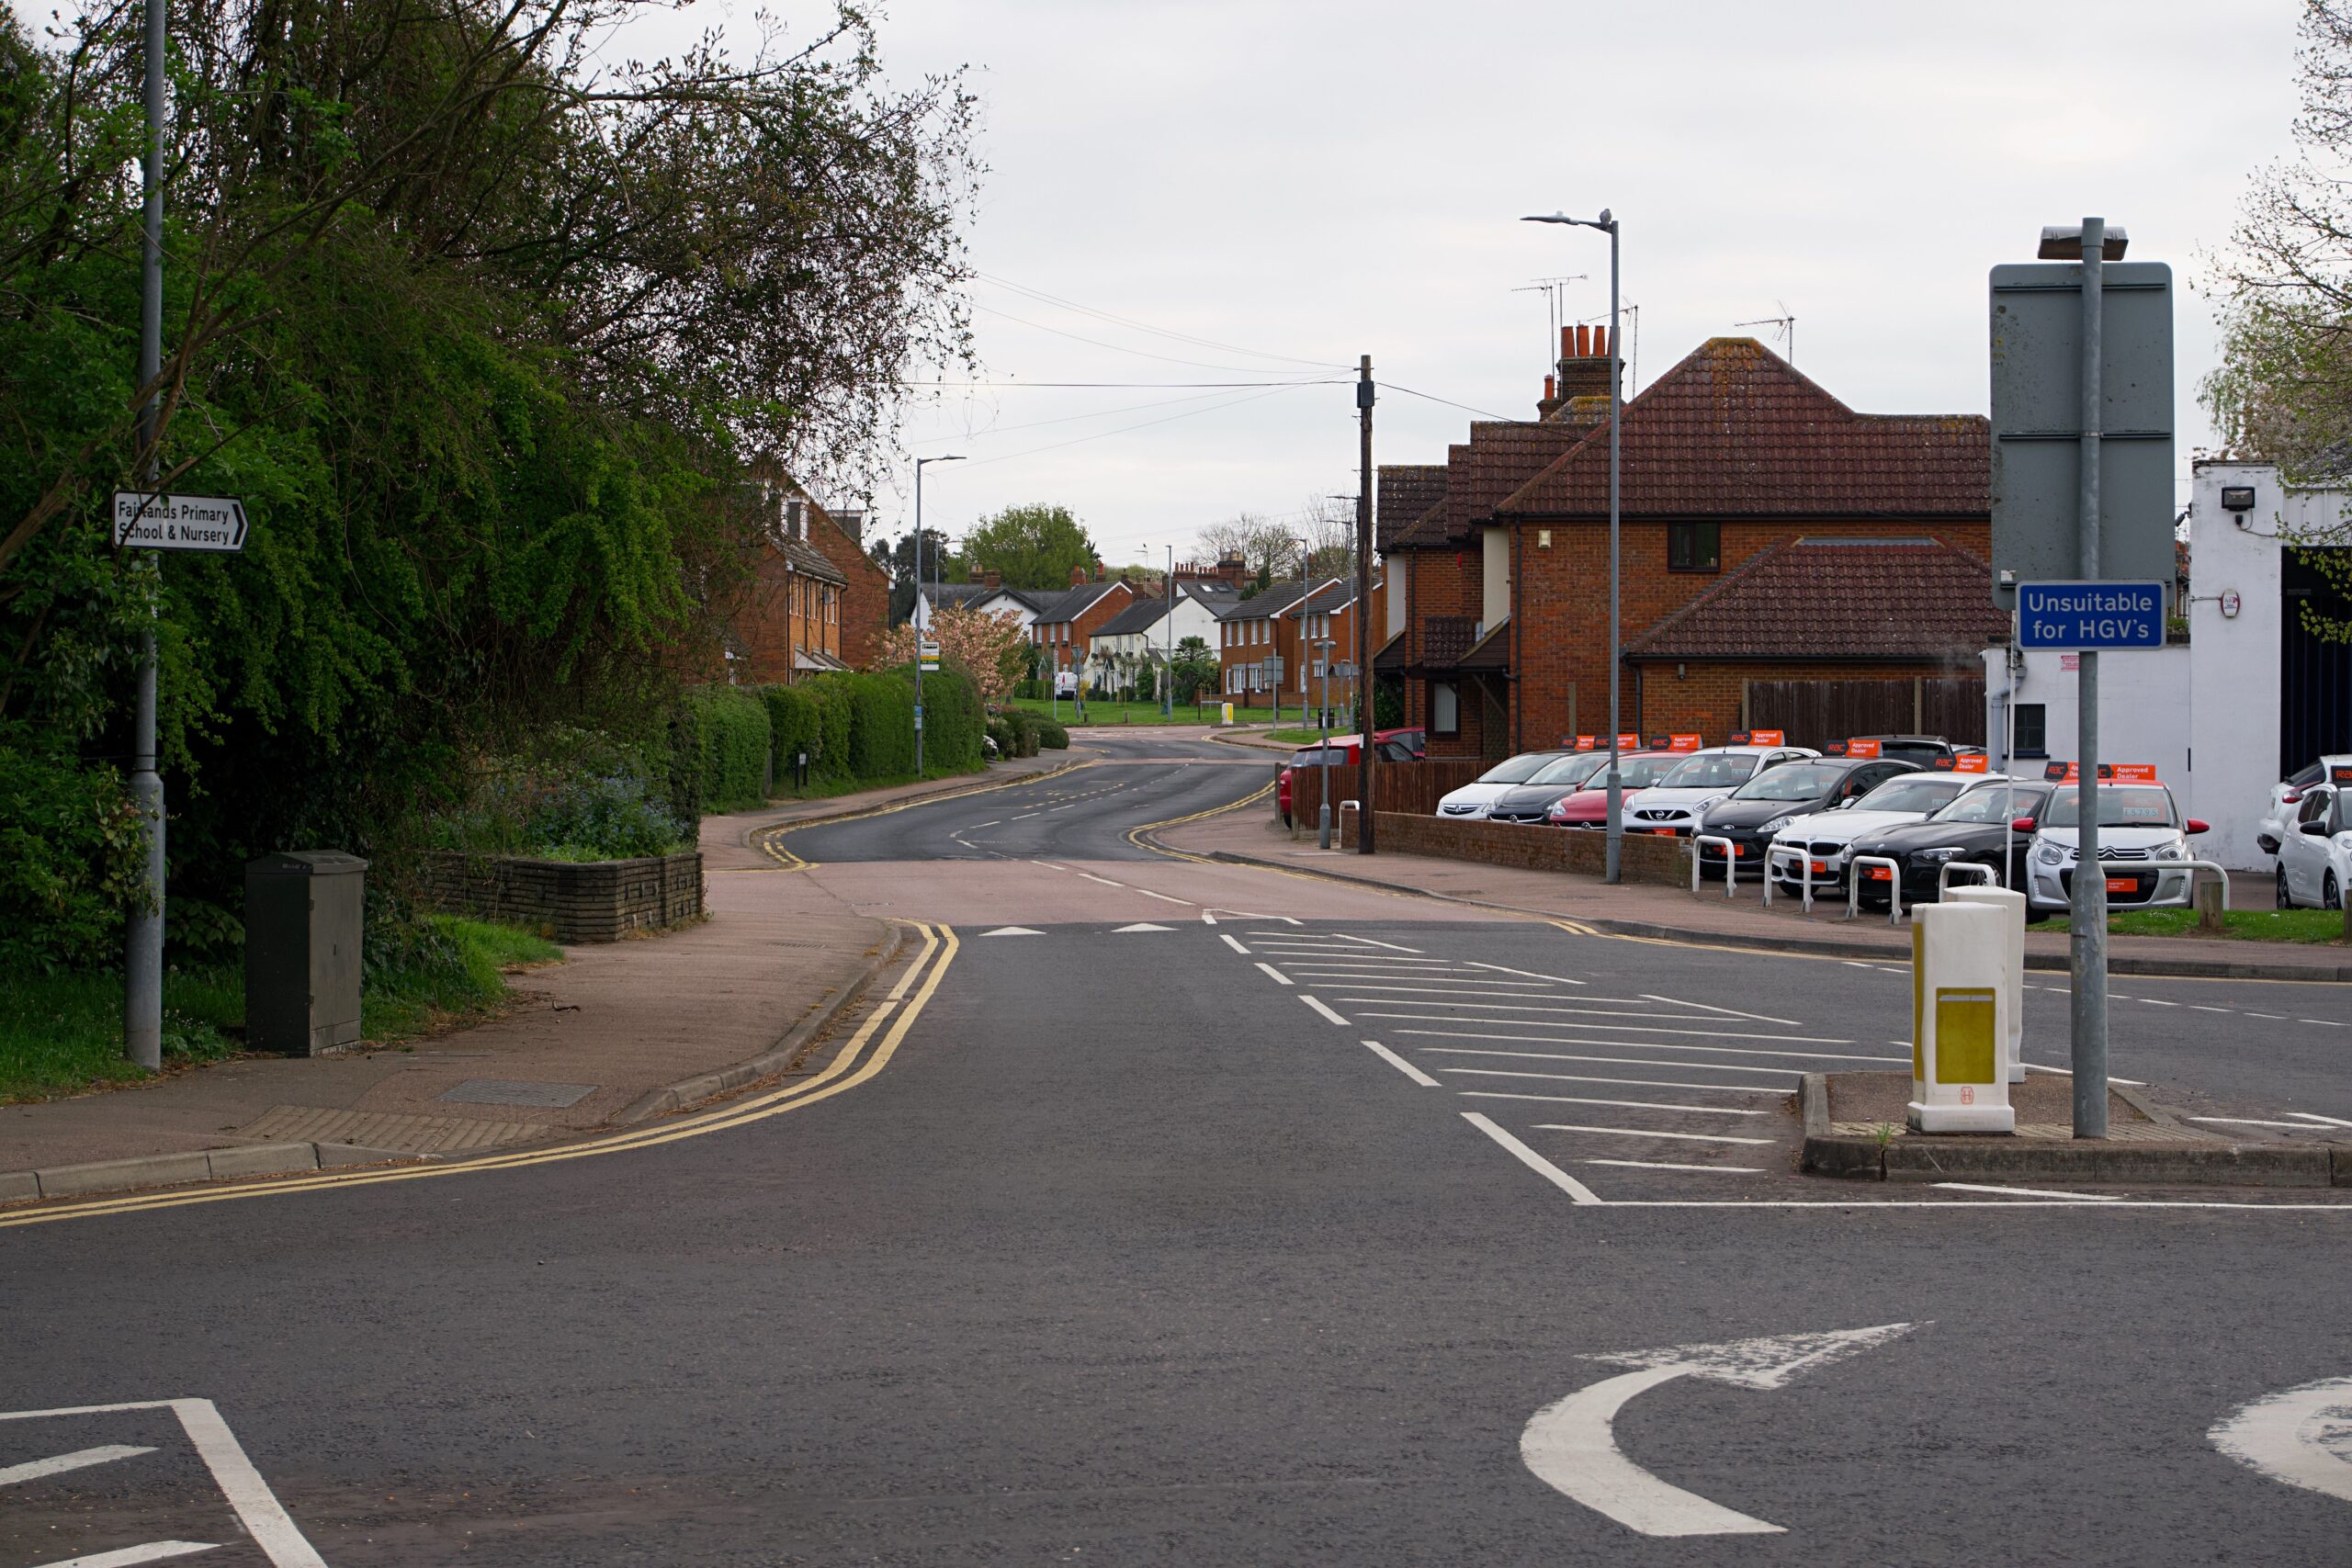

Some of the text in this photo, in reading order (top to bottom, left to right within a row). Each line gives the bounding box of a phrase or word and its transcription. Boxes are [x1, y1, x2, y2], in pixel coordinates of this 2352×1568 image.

[119, 501, 229, 525] Faiands Primary
[119, 523, 229, 545] School & Nursery
[2029, 592, 2153, 612] Unsuitable
[2033, 619, 2149, 639] for HGV's
